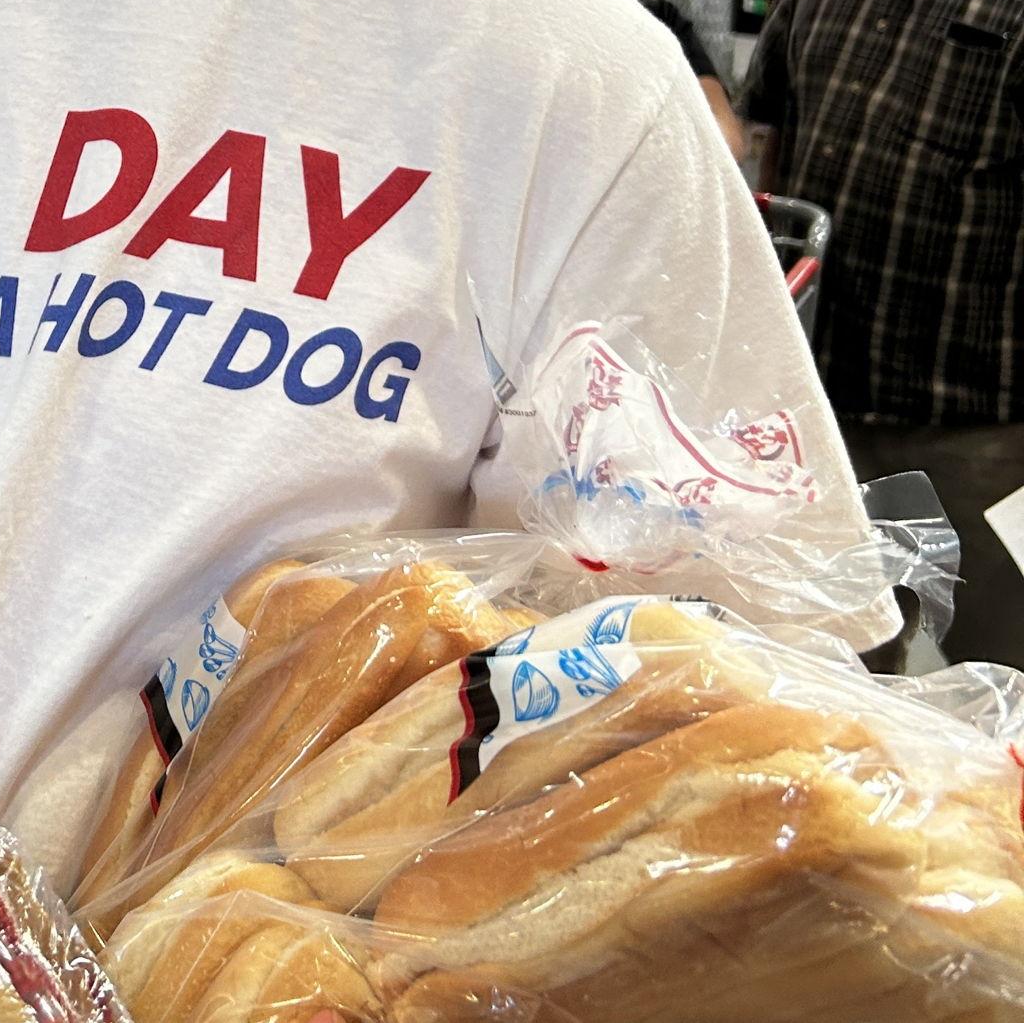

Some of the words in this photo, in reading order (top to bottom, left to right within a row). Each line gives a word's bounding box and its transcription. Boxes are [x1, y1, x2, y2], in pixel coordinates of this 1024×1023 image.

[24, 108, 432, 301] DAY
[28, 273, 213, 371] HOT
[203, 308, 421, 424] DOG
